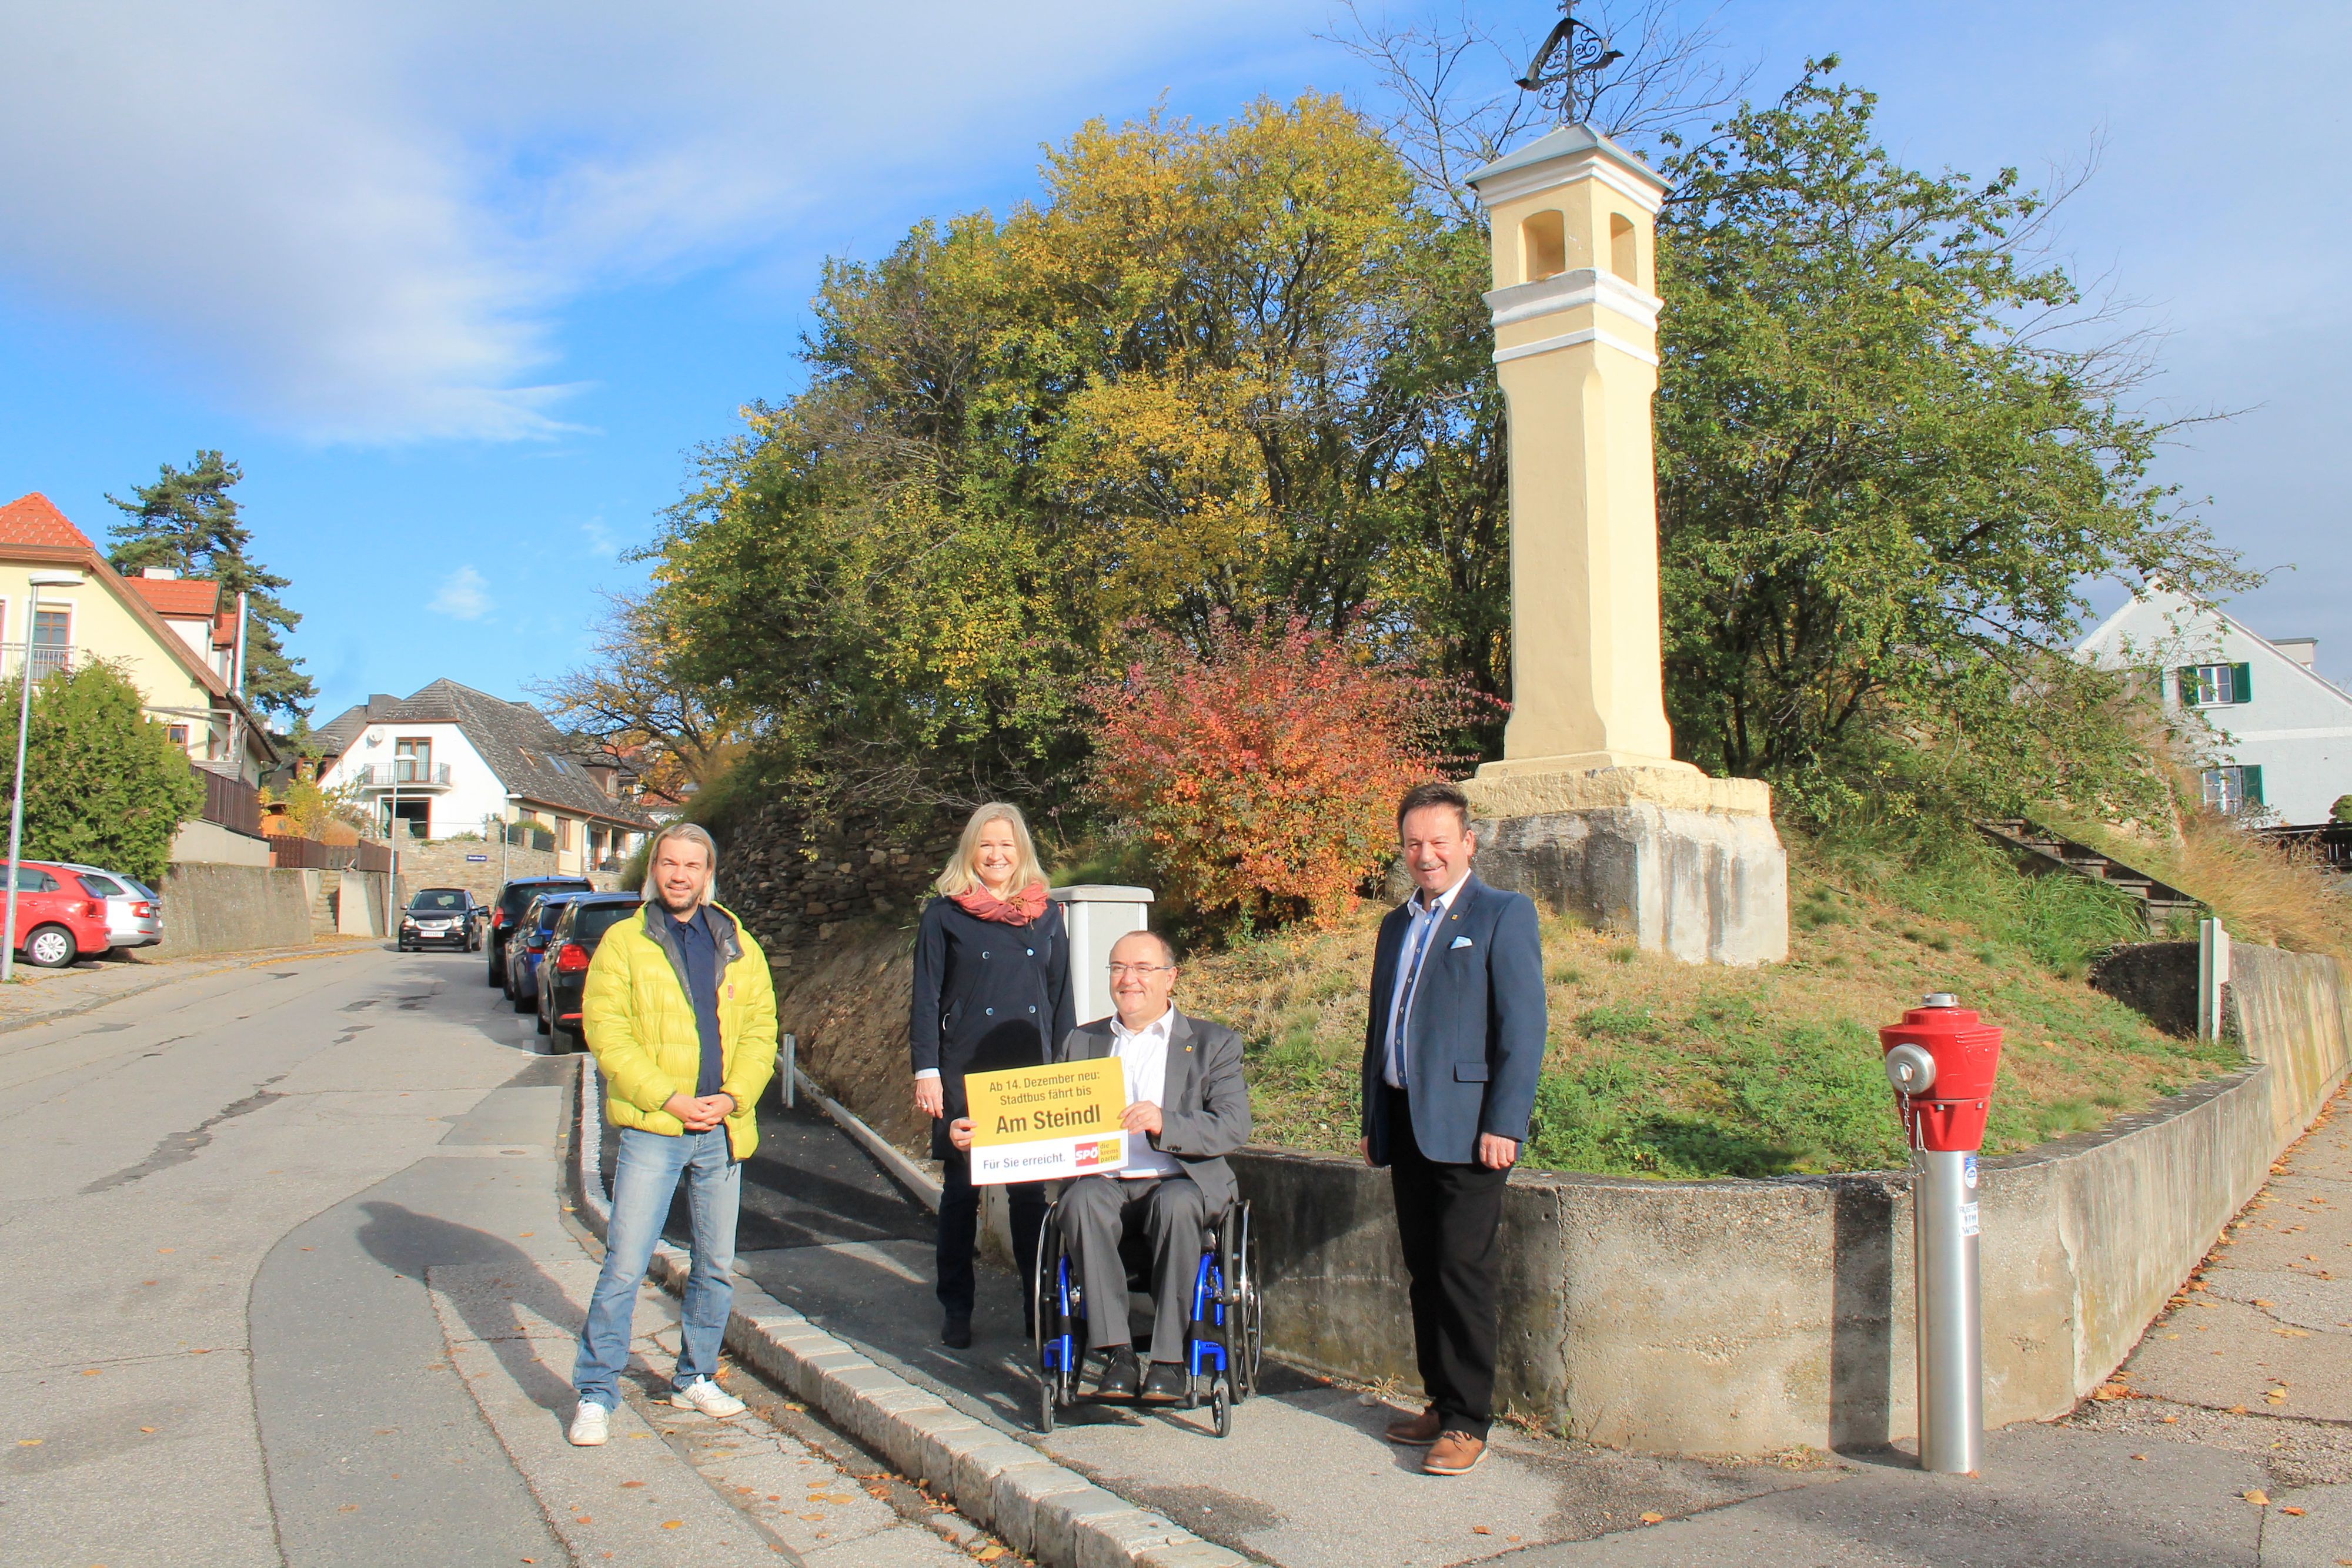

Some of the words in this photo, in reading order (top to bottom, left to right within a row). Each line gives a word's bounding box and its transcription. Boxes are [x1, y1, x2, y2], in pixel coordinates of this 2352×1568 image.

[990, 1081, 1003, 1092] Ab
[1006, 1079, 1021, 1090] 14.
[1024, 1074, 1075, 1088] Dezember
[1078, 1071, 1100, 1081] neu:
[1000, 1092, 1045, 1106] Stadtbus
[1048, 1087, 1074, 1099] fährt
[1076, 1085, 1092, 1096] bis
[996, 1115, 1027, 1134] Am
[1033, 1104, 1101, 1129] Steindl
[983, 1159, 1000, 1169] Für
[1003, 1157, 1020, 1168] Sie
[1023, 1152, 1066, 1166] erreicht.
[1075, 1146, 1098, 1161] SPÖ
[1100, 1154, 1118, 1164] partei
